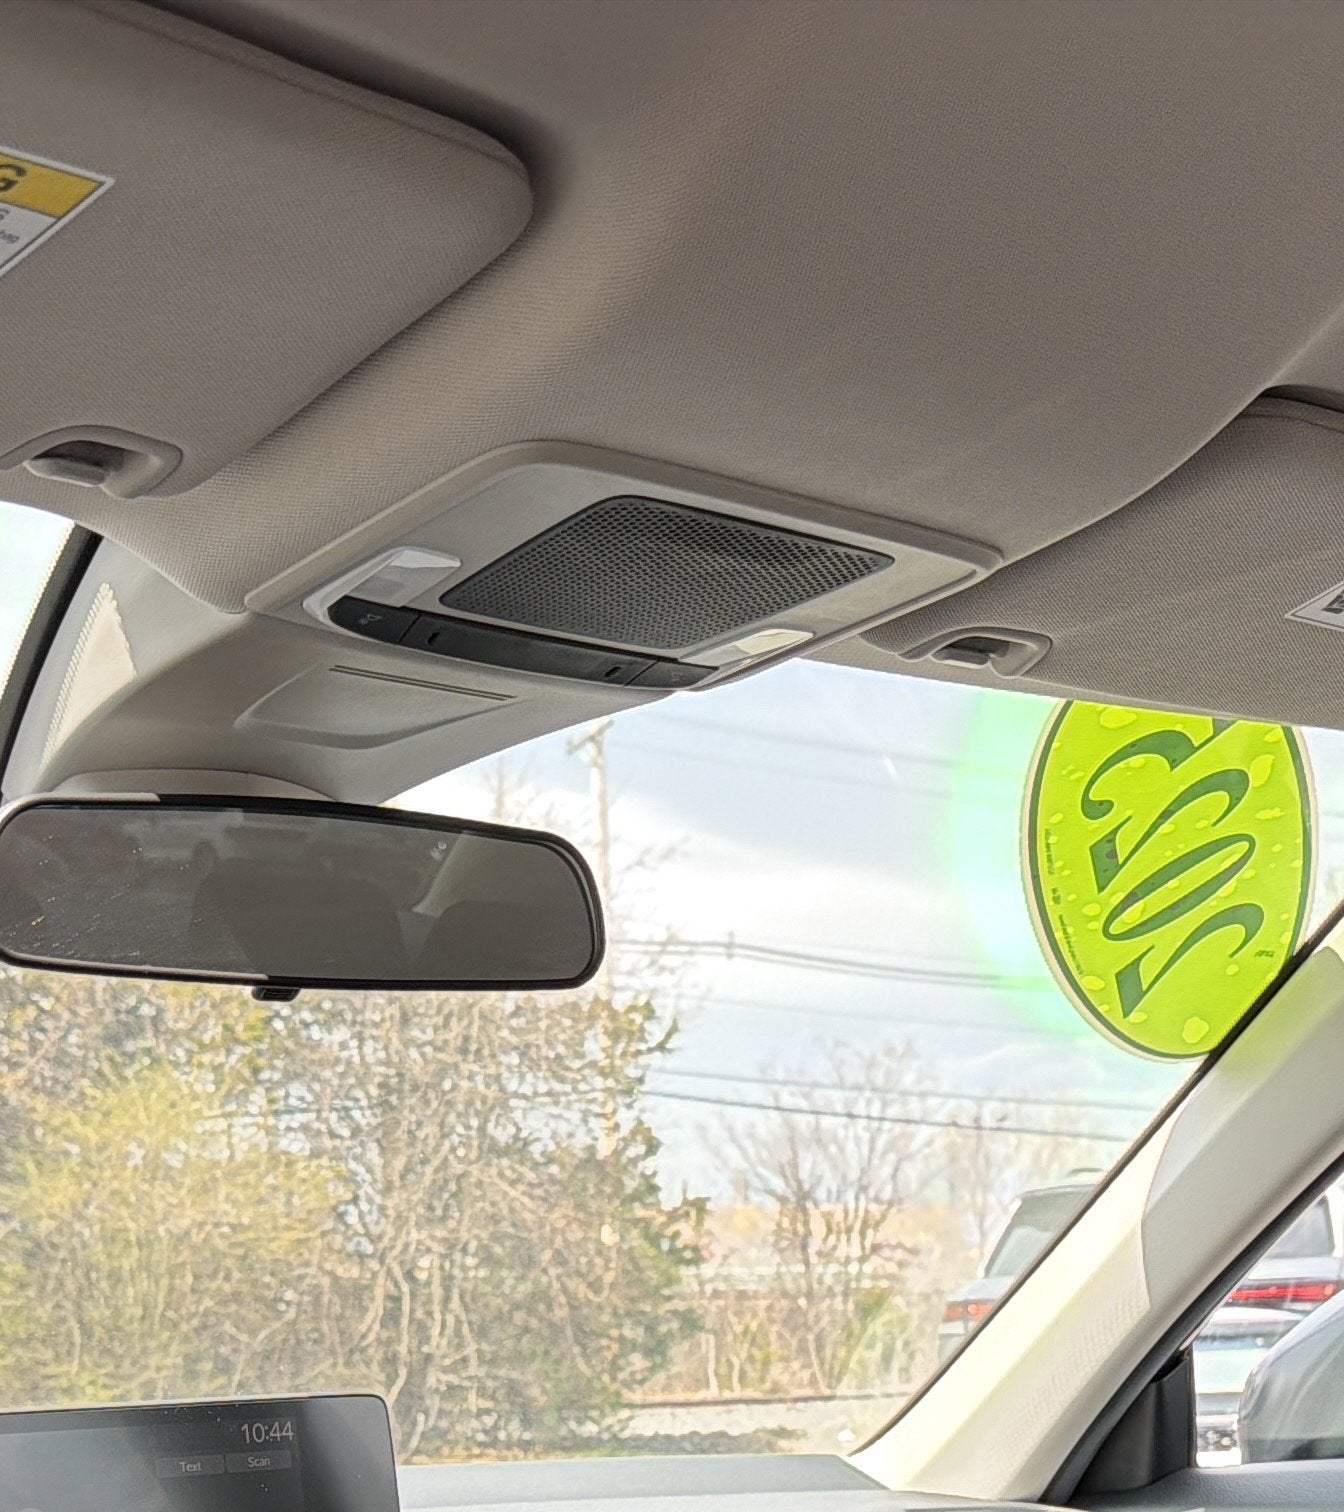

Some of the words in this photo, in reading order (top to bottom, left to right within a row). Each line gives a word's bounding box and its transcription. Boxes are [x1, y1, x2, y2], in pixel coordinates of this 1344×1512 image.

[241, 1421, 294, 1443] 10:44
[179, 1461, 201, 1472] Text
[248, 1456, 270, 1468] Scan
